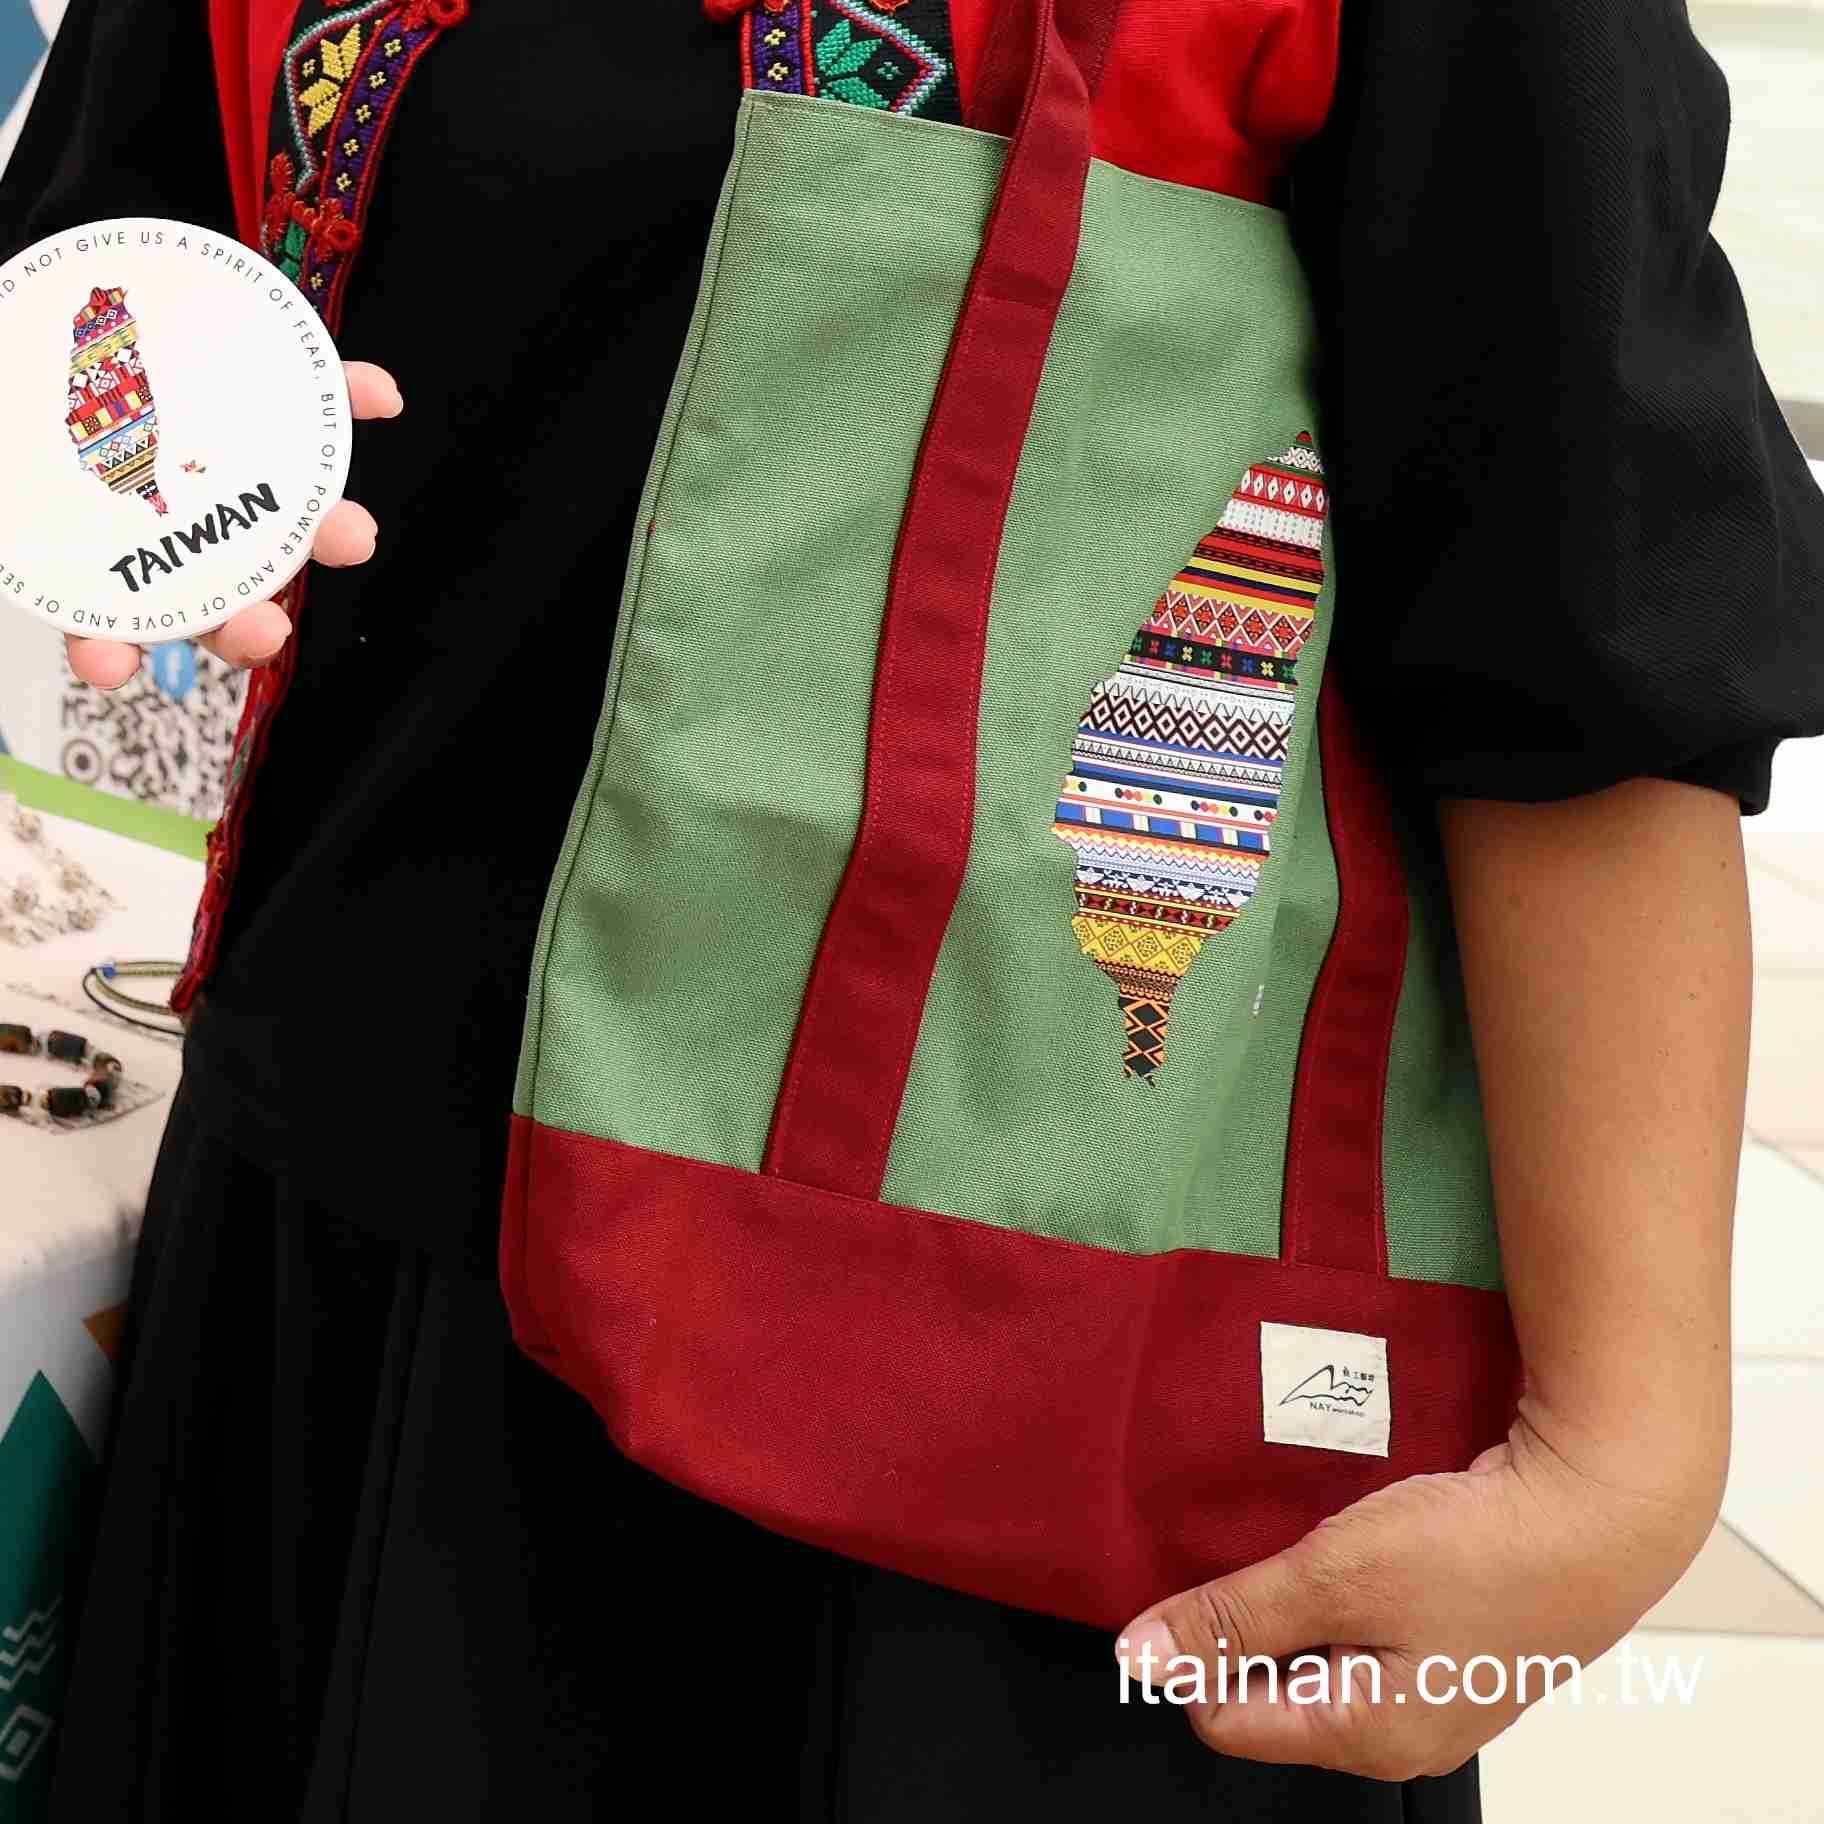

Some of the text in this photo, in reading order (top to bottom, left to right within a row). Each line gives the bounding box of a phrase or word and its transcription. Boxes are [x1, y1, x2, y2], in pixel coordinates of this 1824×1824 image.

[75, 231, 126, 252] GIVE
[139, 231, 164, 245] US
[177, 236, 189, 249] A
[23, 247, 64, 278] NOT
[201, 241, 264, 285] SPIRIT
[268, 287, 294, 315] OF
[320, 392, 337, 430] BUT
[320, 444, 336, 474] OF
[279, 484, 326, 558] POWER
[109, 483, 281, 593] TAIWAN
[236, 559, 276, 598] AND
[33, 592, 61, 616] OF
[200, 595, 227, 619] OF
[72, 609, 118, 630] AND
[131, 610, 187, 631] LOVE
